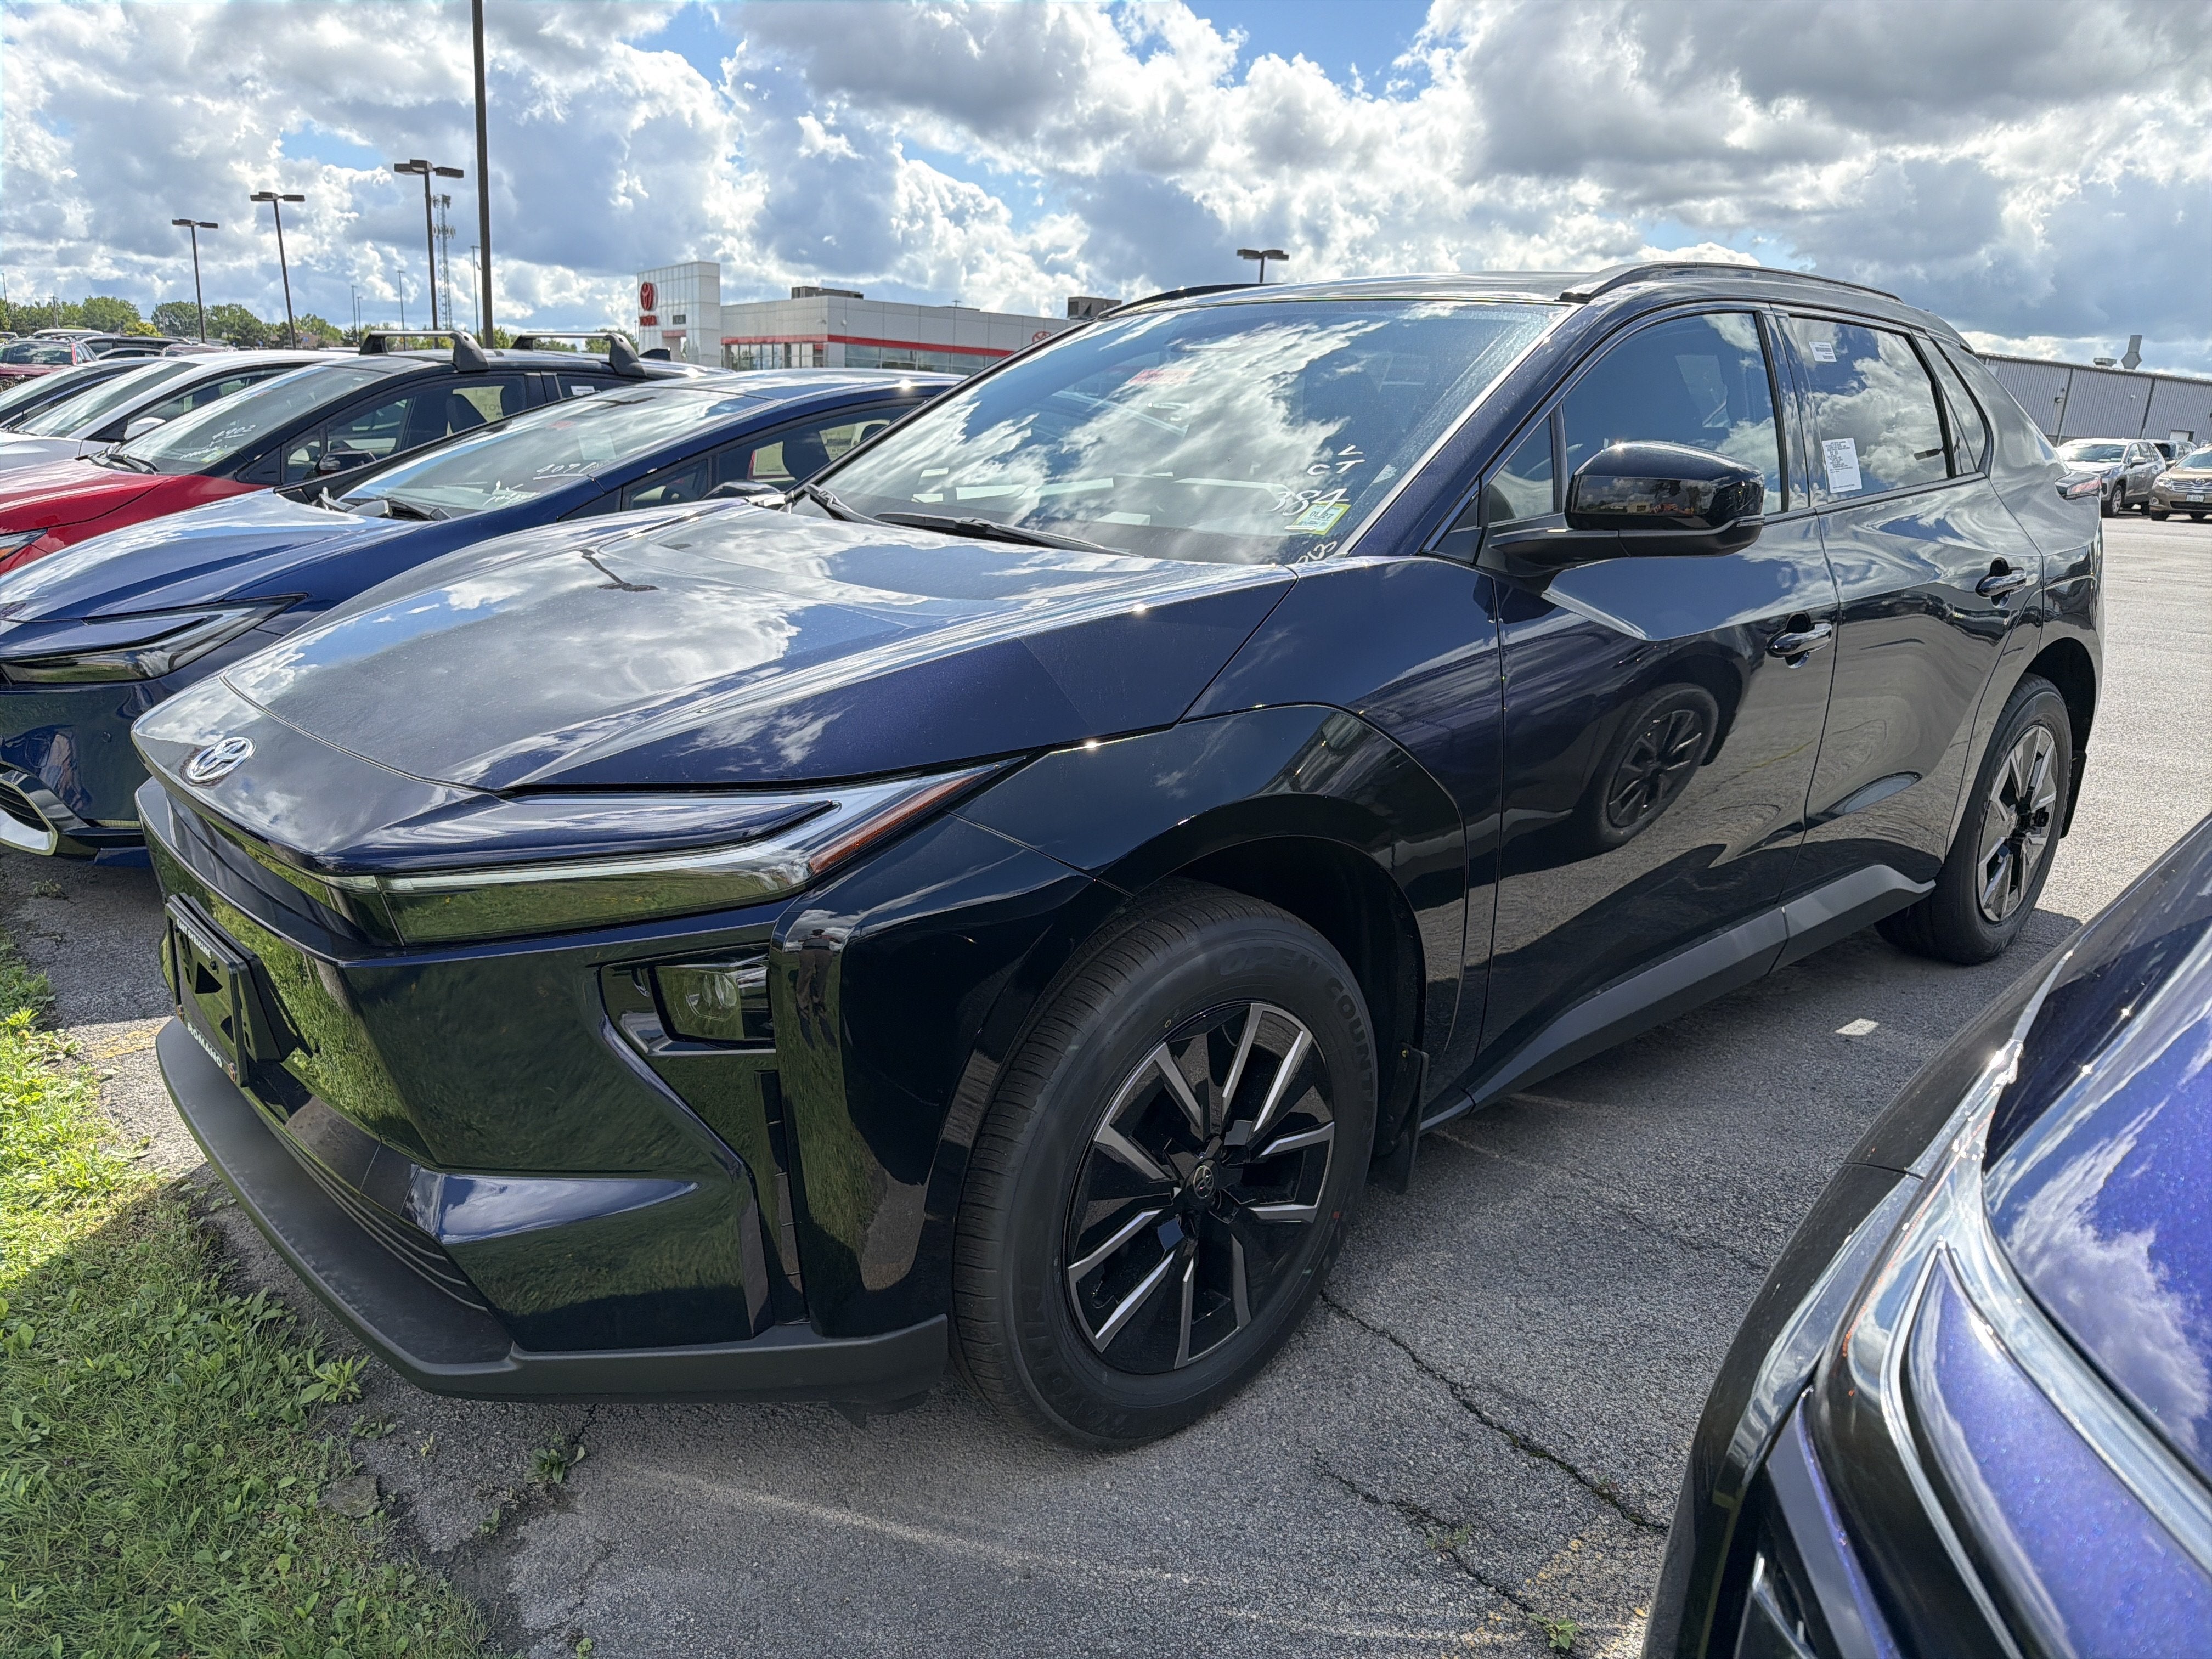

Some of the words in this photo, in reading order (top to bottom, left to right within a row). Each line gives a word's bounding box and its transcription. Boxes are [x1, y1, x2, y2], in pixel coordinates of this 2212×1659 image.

[1268, 488, 1350, 517] 384
[176, 918, 188, 935] EAST
[188, 929, 211, 960] SYRACUSE
[1219, 947, 1318, 976] OPEN
[187, 1022, 223, 1068] ROMANO
